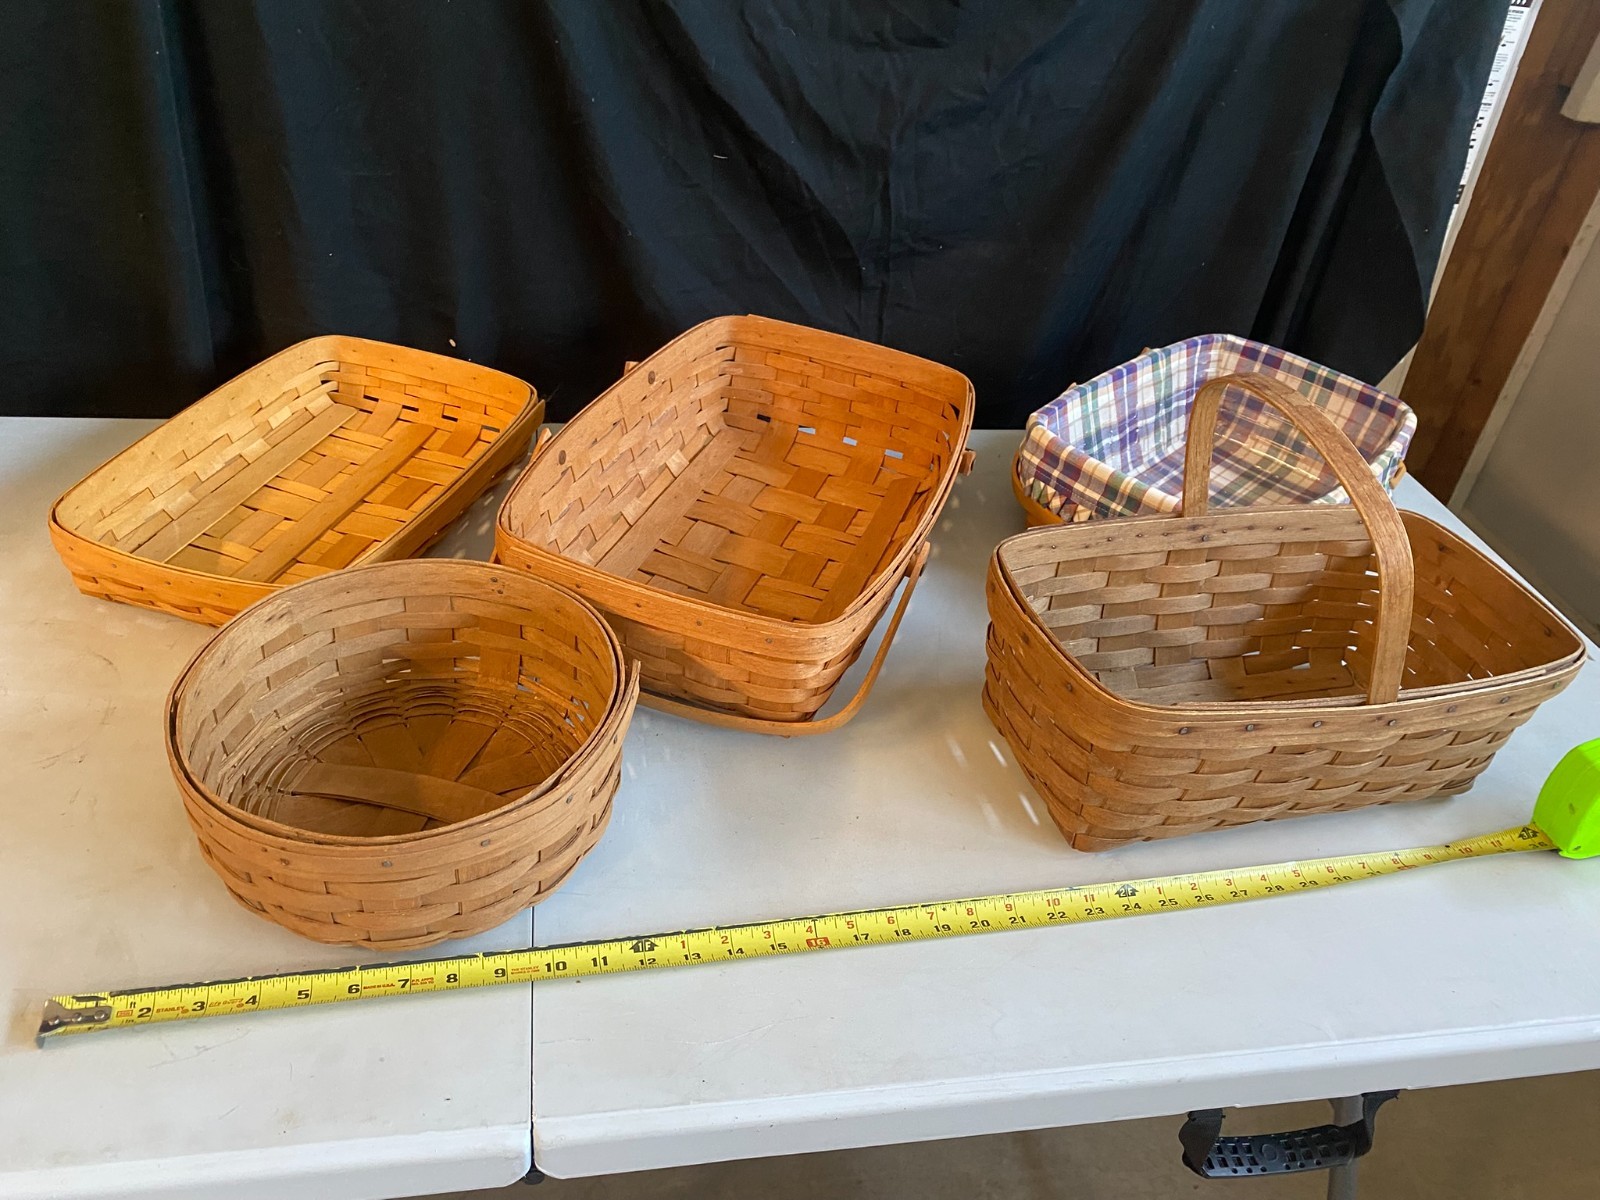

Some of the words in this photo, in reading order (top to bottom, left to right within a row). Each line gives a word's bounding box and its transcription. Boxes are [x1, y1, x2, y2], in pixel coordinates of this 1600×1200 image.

[1490, 840, 1503, 848] 11
[1458, 847, 1472, 855] 10
[1157, 887, 1162, 895] 1
[1230, 890, 1248, 898] 27
[1046, 898, 1060, 907] 10
[1084, 894, 1095, 903] 11
[1122, 903, 1142, 911] 24
[1158, 899, 1178, 907] 25
[966, 908, 974, 916] 8
[1005, 904, 1013, 912] 9
[1085, 907, 1105, 916] 23
[926, 912, 934, 920] 7
[1009, 916, 1026, 924] 21
[1047, 912, 1067, 920] 22
[887, 916, 895, 925] 6
[970, 920, 990, 929] 20
[846, 921, 855, 929] 5
[934, 924, 951, 932] 19
[806, 926, 813, 934] 4
[894, 929, 911, 937] 18
[764, 931, 771, 939] 3
[853, 933, 869, 942] 17
[721, 936, 729, 944] 2
[809, 939, 827, 947] 16
[680, 940, 686, 949] 1
[770, 943, 788, 951] 15
[727, 948, 745, 956] 14
[683, 953, 701, 961] 13
[591, 956, 608, 967] 11
[639, 958, 657, 966] 12
[545, 961, 567, 972] 10
[494, 968, 506, 978] 9
[446, 973, 458, 983] 8
[398, 978, 410, 988] 7
[348, 984, 360, 994] 6
[297, 989, 310, 999] 5
[245, 995, 257, 1005] 4
[192, 1001, 205, 1012] 3
[137, 1007, 151, 1018] 2
